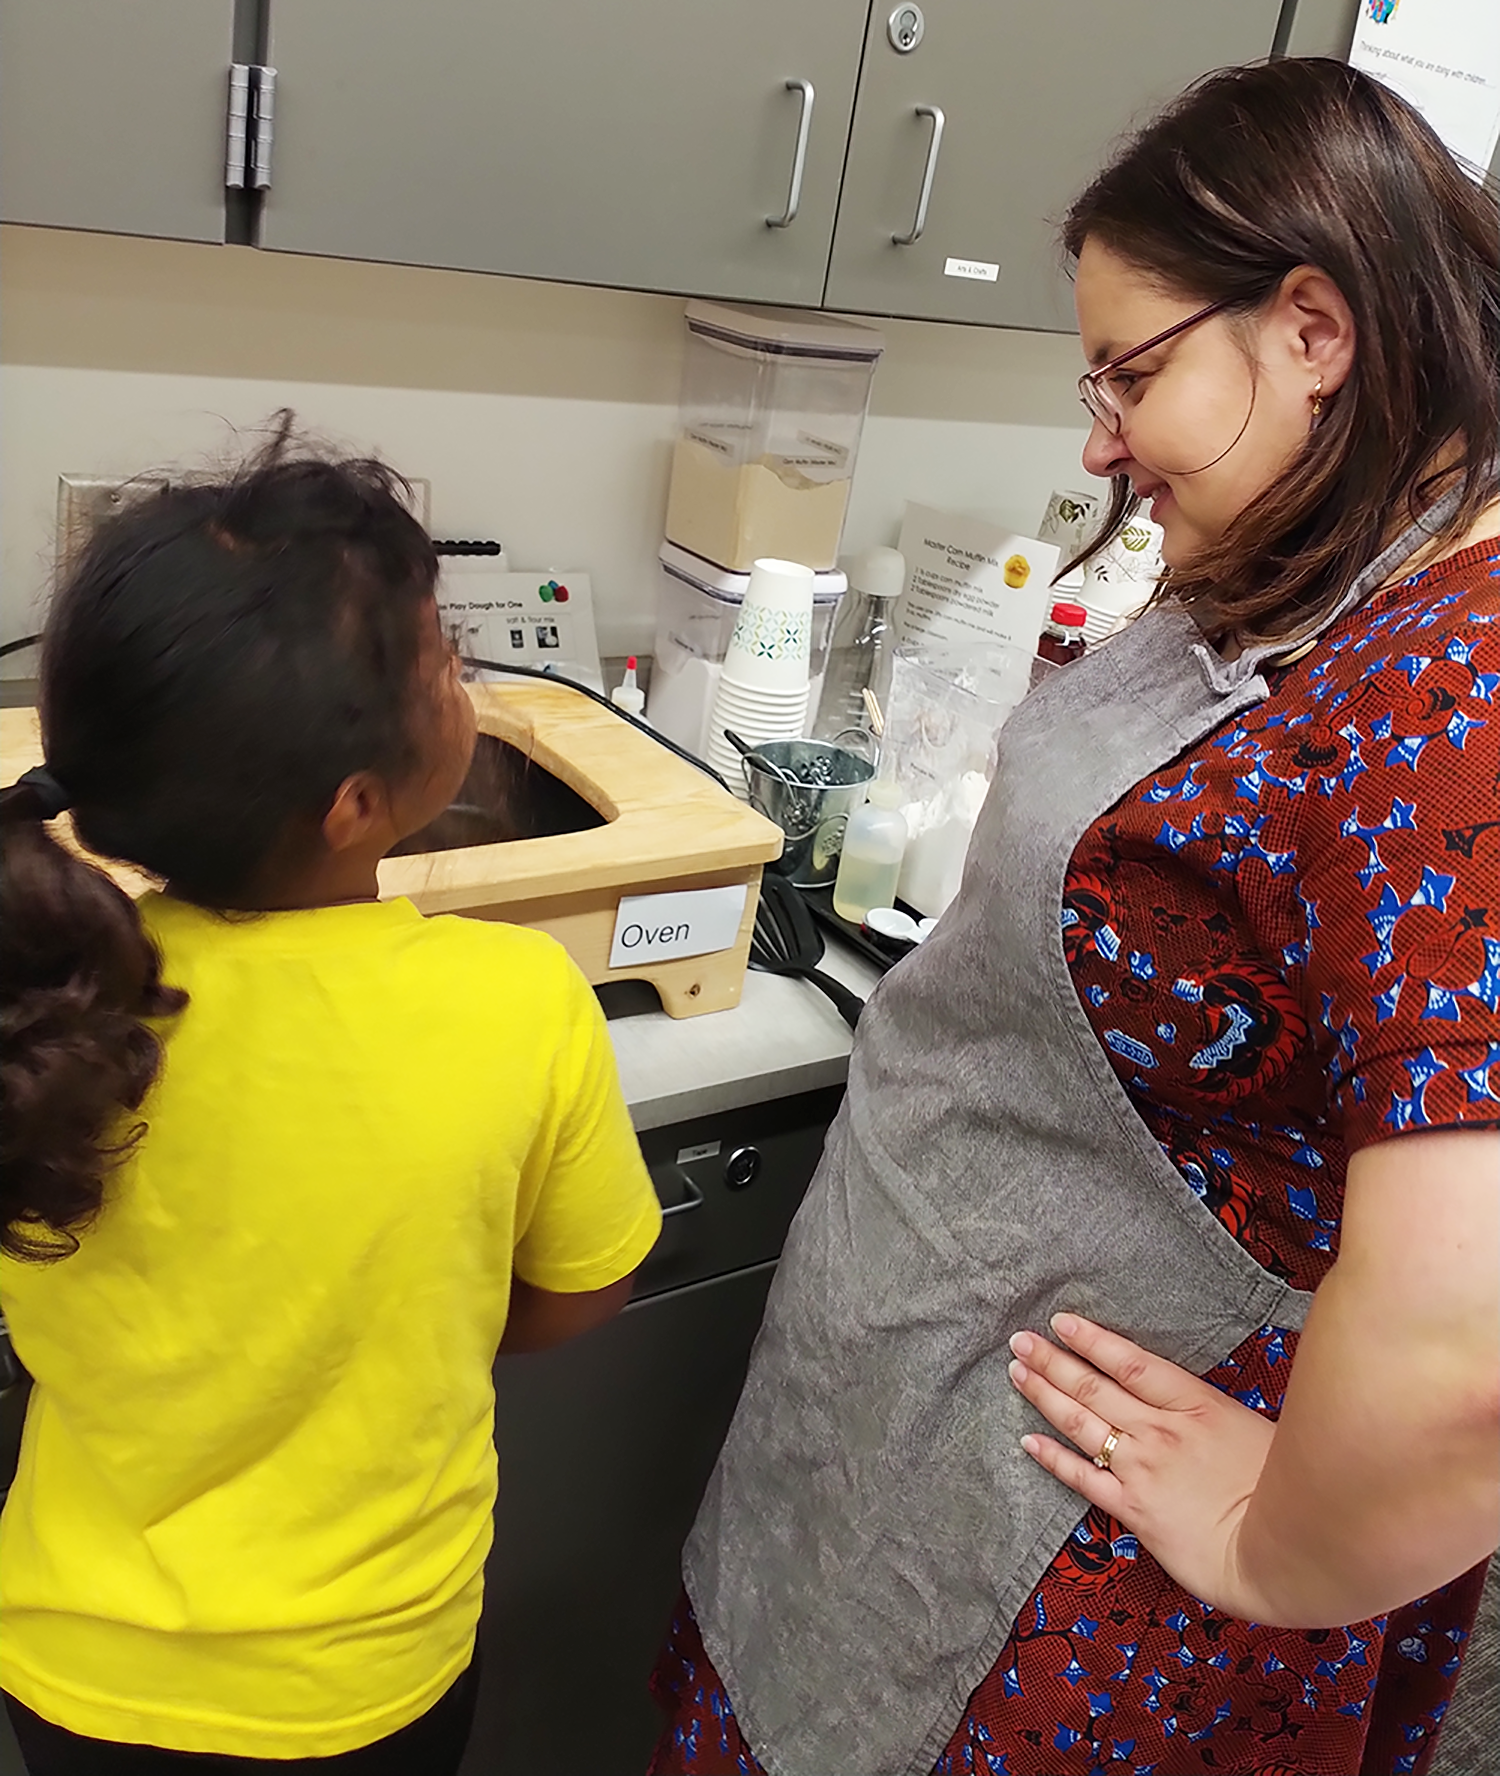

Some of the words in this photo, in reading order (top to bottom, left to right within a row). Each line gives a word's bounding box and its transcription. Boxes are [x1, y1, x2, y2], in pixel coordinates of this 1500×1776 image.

[1382, 50, 1400, 60] about
[1401, 55, 1414, 65] what
[1413, 60, 1425, 69] you
[1425, 63, 1434, 71] are
[1435, 65, 1450, 78] doing
[1451, 70, 1464, 78] with
[924, 538, 946, 551] Master
[946, 545, 963, 555] Corn
[965, 551, 986, 562] Muffin
[987, 557, 999, 567] Mix
[946, 556, 971, 571] Recipe
[940, 576, 953, 584] corn
[955, 580, 972, 589] muffin
[450, 602, 466, 611] Play
[469, 601, 494, 611] Dough
[495, 601, 506, 609] for
[507, 600, 523, 609] One
[950, 598, 981, 613] powdered
[976, 598, 999, 609] powder
[506, 616, 519, 624] salt
[521, 616, 527, 624] &
[621, 923, 690, 948] Oven
